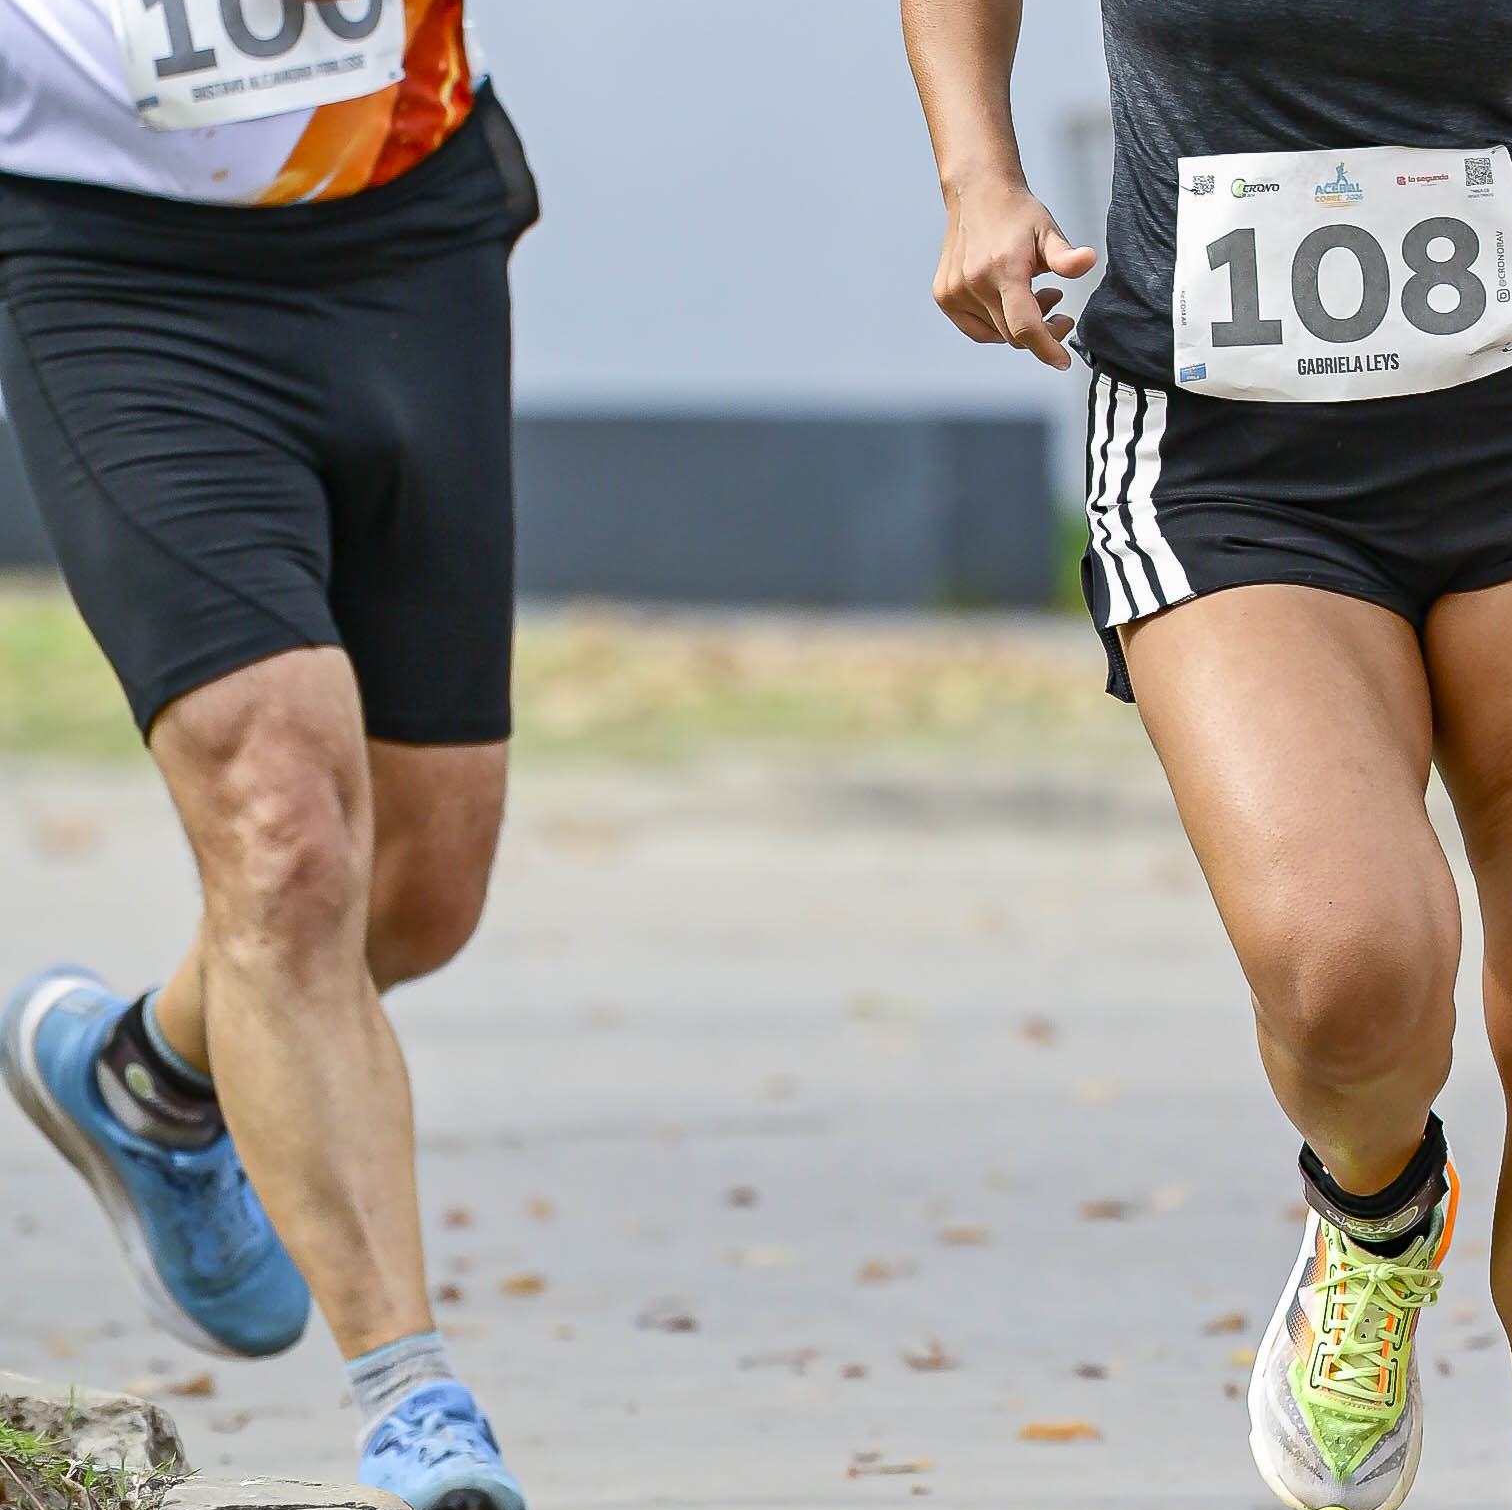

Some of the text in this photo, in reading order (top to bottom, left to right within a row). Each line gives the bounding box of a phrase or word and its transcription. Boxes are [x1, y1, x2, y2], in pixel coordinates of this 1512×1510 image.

[1206, 217, 1487, 347] 108
[1297, 353, 1400, 375] GABRIELA LEYS
